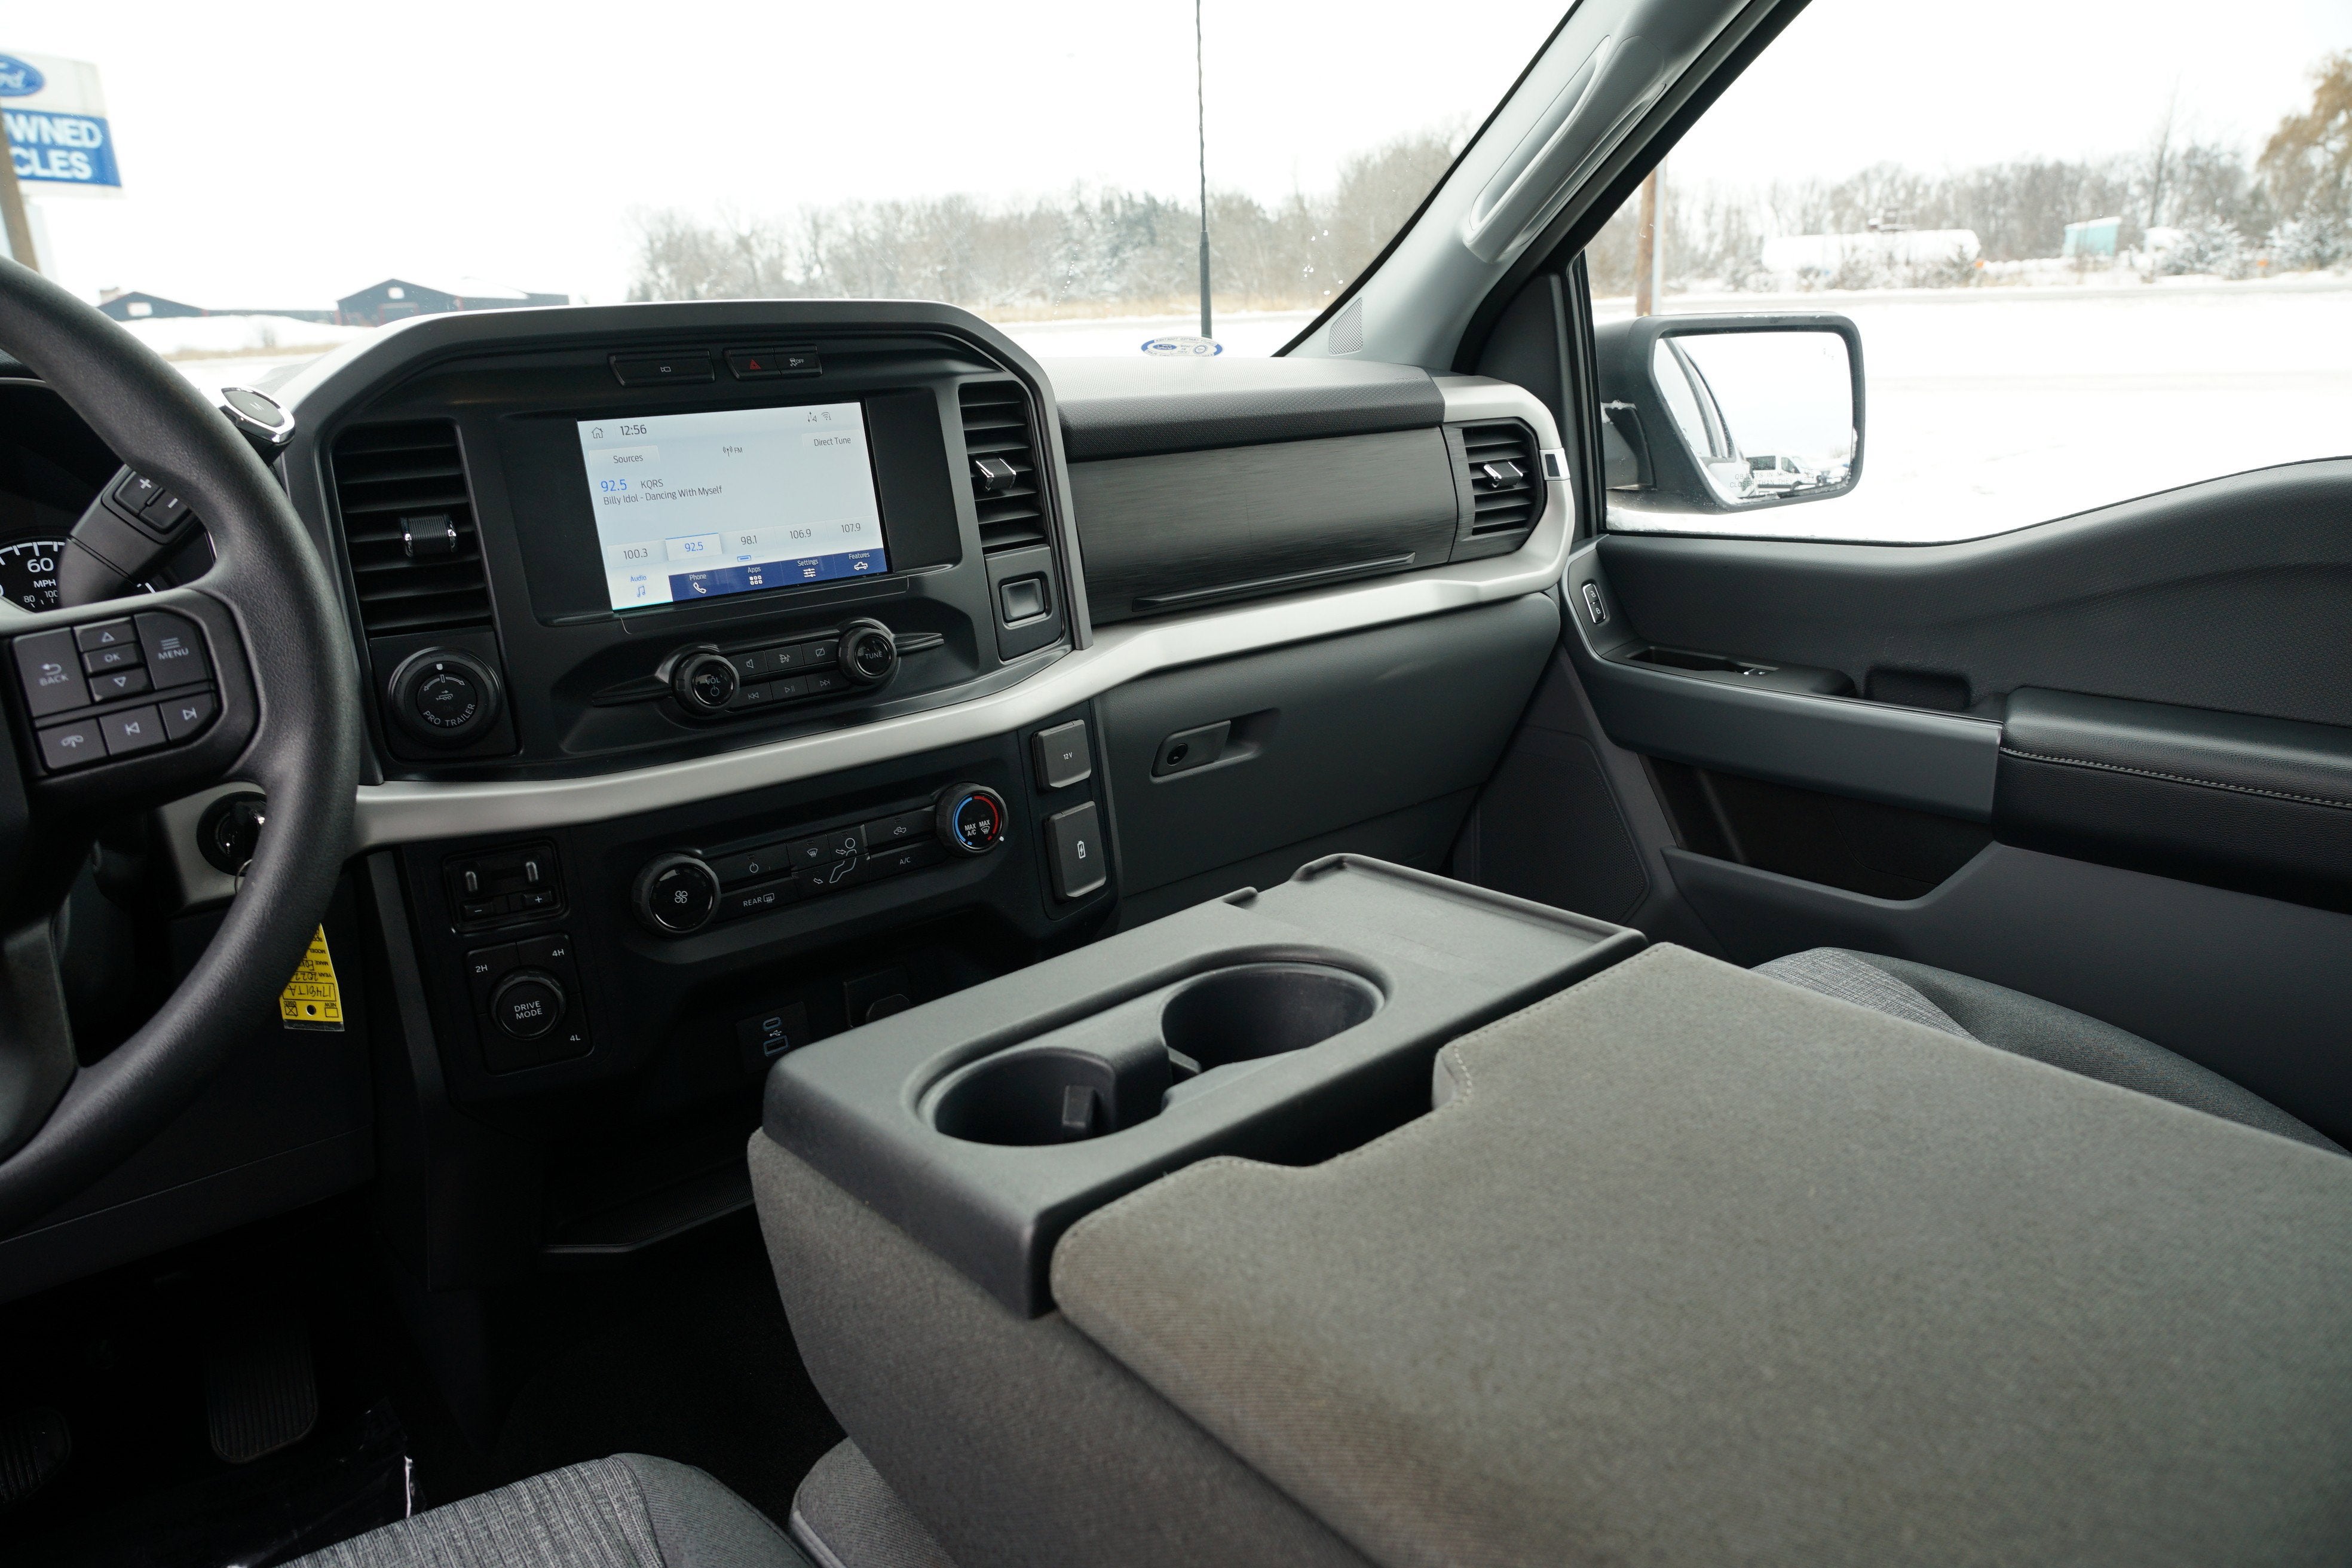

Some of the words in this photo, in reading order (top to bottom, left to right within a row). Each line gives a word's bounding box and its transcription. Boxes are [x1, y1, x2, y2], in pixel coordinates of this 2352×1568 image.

[620, 424, 647, 436] 12:56
[814, 437, 834, 447] Direct
[834, 436, 852, 445] Tune
[613, 454, 644, 464] Sources
[601, 479, 627, 492] 92.5
[641, 479, 664, 490] KQRS
[604, 495, 621, 506] Billy
[623, 494, 639, 504] Idol
[645, 491, 677, 502] Dancing
[679, 487, 697, 498] With
[698, 485, 723, 497] Myself
[841, 523, 861, 533] 107.9
[789, 528, 811, 539] 106.9
[740, 535, 758, 545] 98.1
[685, 541, 704, 552] 92.5
[623, 548, 648, 560] 100.3
[849, 552, 870, 560] Features
[27, 558, 54, 573] 60
[797, 558, 819, 566] Settings
[33, 579, 57, 588] MPH
[23, 595, 36, 604] 80
[104, 653, 121, 663] OK
[158, 647, 189, 660] MENU
[865, 650, 883, 660] TUNE
[39, 673, 69, 687] BACK
[705, 677, 721, 685] VOL
[423, 710, 441, 725] PRO
[445, 703, 476, 727] TRAILER
[1063, 752, 1073, 760] 12V
[964, 823, 976, 831] MAX
[979, 819, 990, 828] MAX
[899, 856, 911, 865] A/C
[743, 897, 762, 908] REAR
[552, 949, 565, 957] 4H
[475, 964, 488, 973] 2H
[514, 1000, 541, 1013] DRIVE
[516, 1008, 543, 1021] MODE
[569, 1034, 581, 1042] 4L
